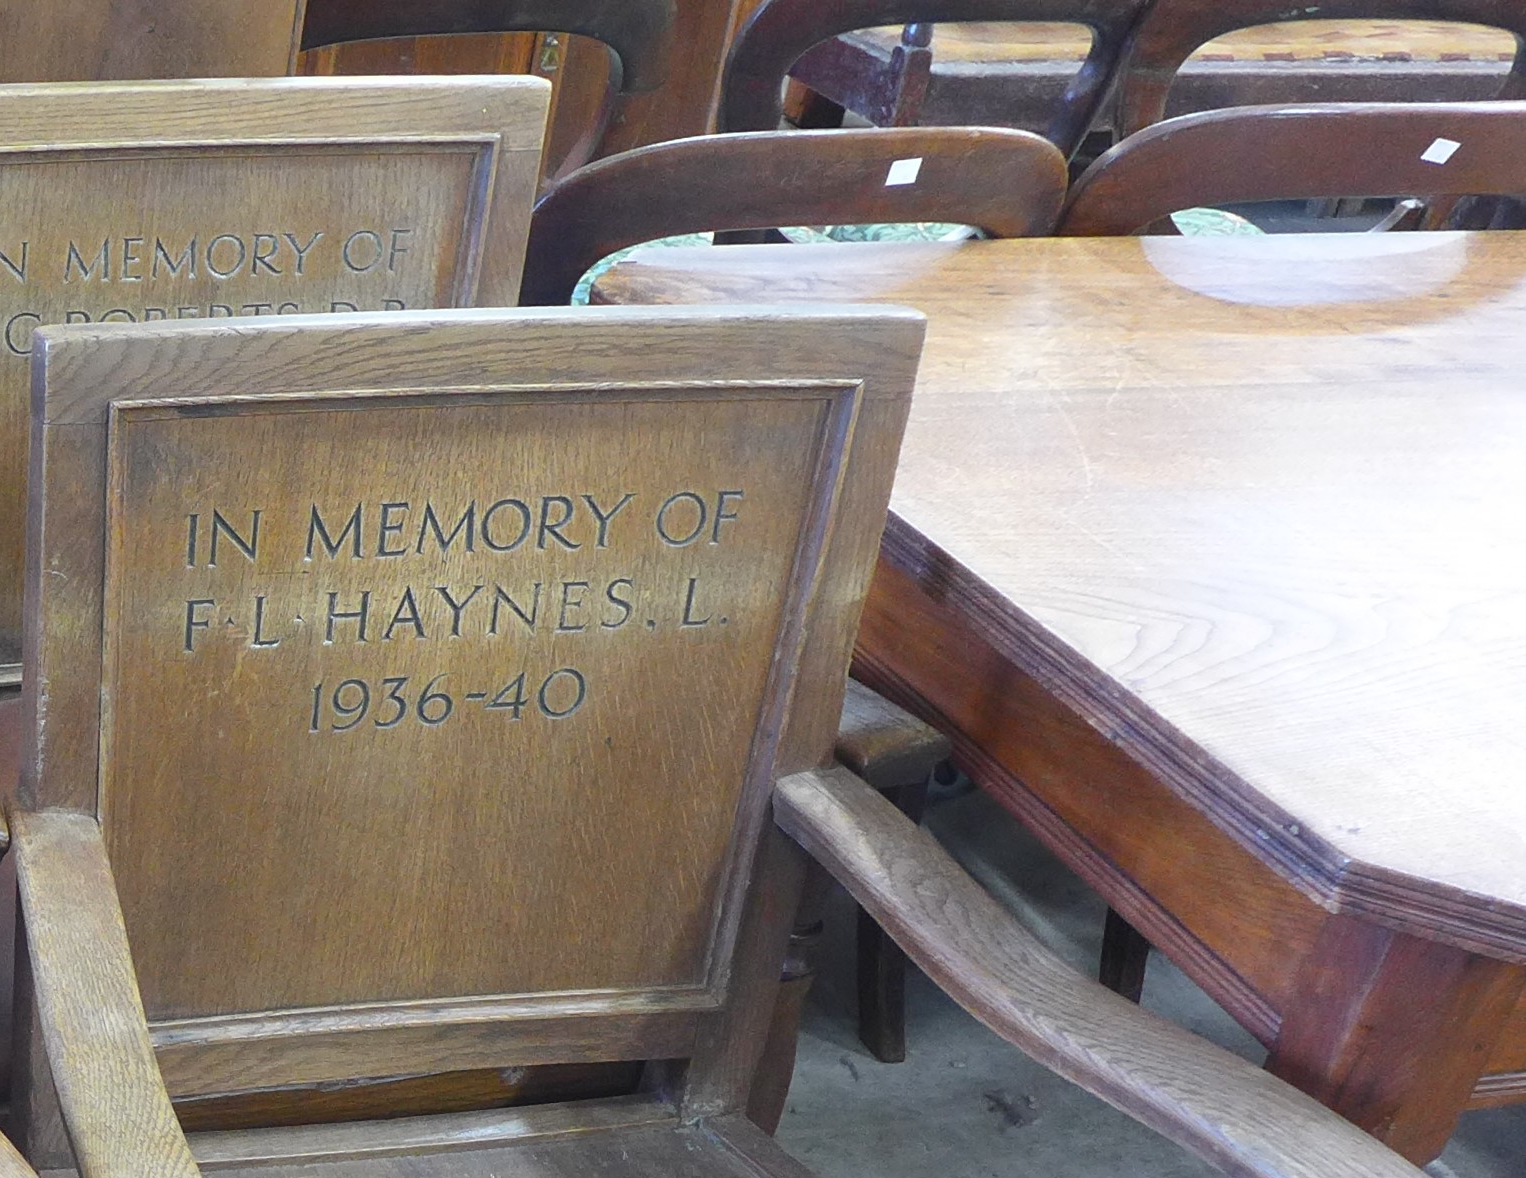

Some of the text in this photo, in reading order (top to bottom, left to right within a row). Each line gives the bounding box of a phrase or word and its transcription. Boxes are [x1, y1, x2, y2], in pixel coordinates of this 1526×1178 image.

[63, 232, 322, 284] MEMORY
[342, 228, 411, 274] OF
[186, 489, 744, 568] IN MEMORY OF
[309, 667, 587, 734] 1936-40
